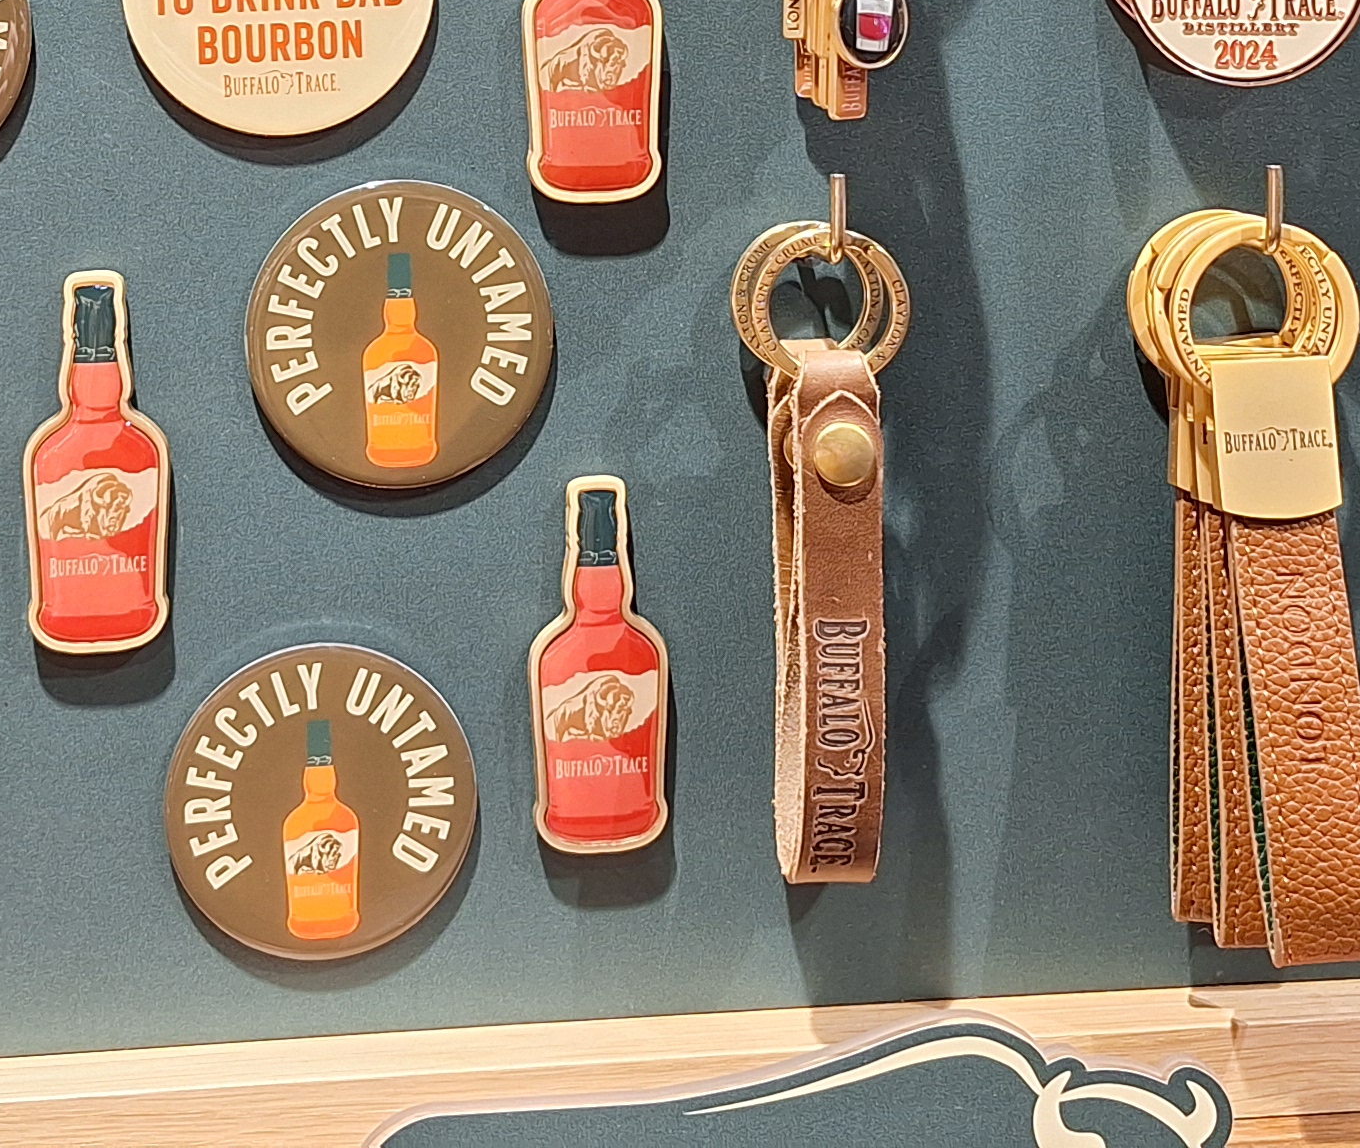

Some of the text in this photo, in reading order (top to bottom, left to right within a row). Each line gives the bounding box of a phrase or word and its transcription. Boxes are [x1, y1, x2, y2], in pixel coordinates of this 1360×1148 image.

[197, 19, 363, 65] BOURBON
[1183, 22, 1299, 35] DISTILLERY
[1215, 40, 1277, 69] 2024
[224, 73, 279, 98] BUFFALO
[549, 107, 642, 128] BUFFALO TRACE
[266, 196, 532, 416] PERFECTLY UNTAMED
[755, 283, 777, 352] CLAYTON
[775, 235, 821, 264] CRUME
[886, 280, 906, 349] CLAYTON
[1178, 288, 1211, 384] UNTAMED
[1224, 431, 1276, 454] BUFFALO
[49, 555, 147, 578] BUFFALO TRACE
[813, 618, 870, 749] BUFFALO
[184, 662, 455, 890] PERFECTLY UNTAMED
[555, 755, 648, 779] BUFFALO TRACE
